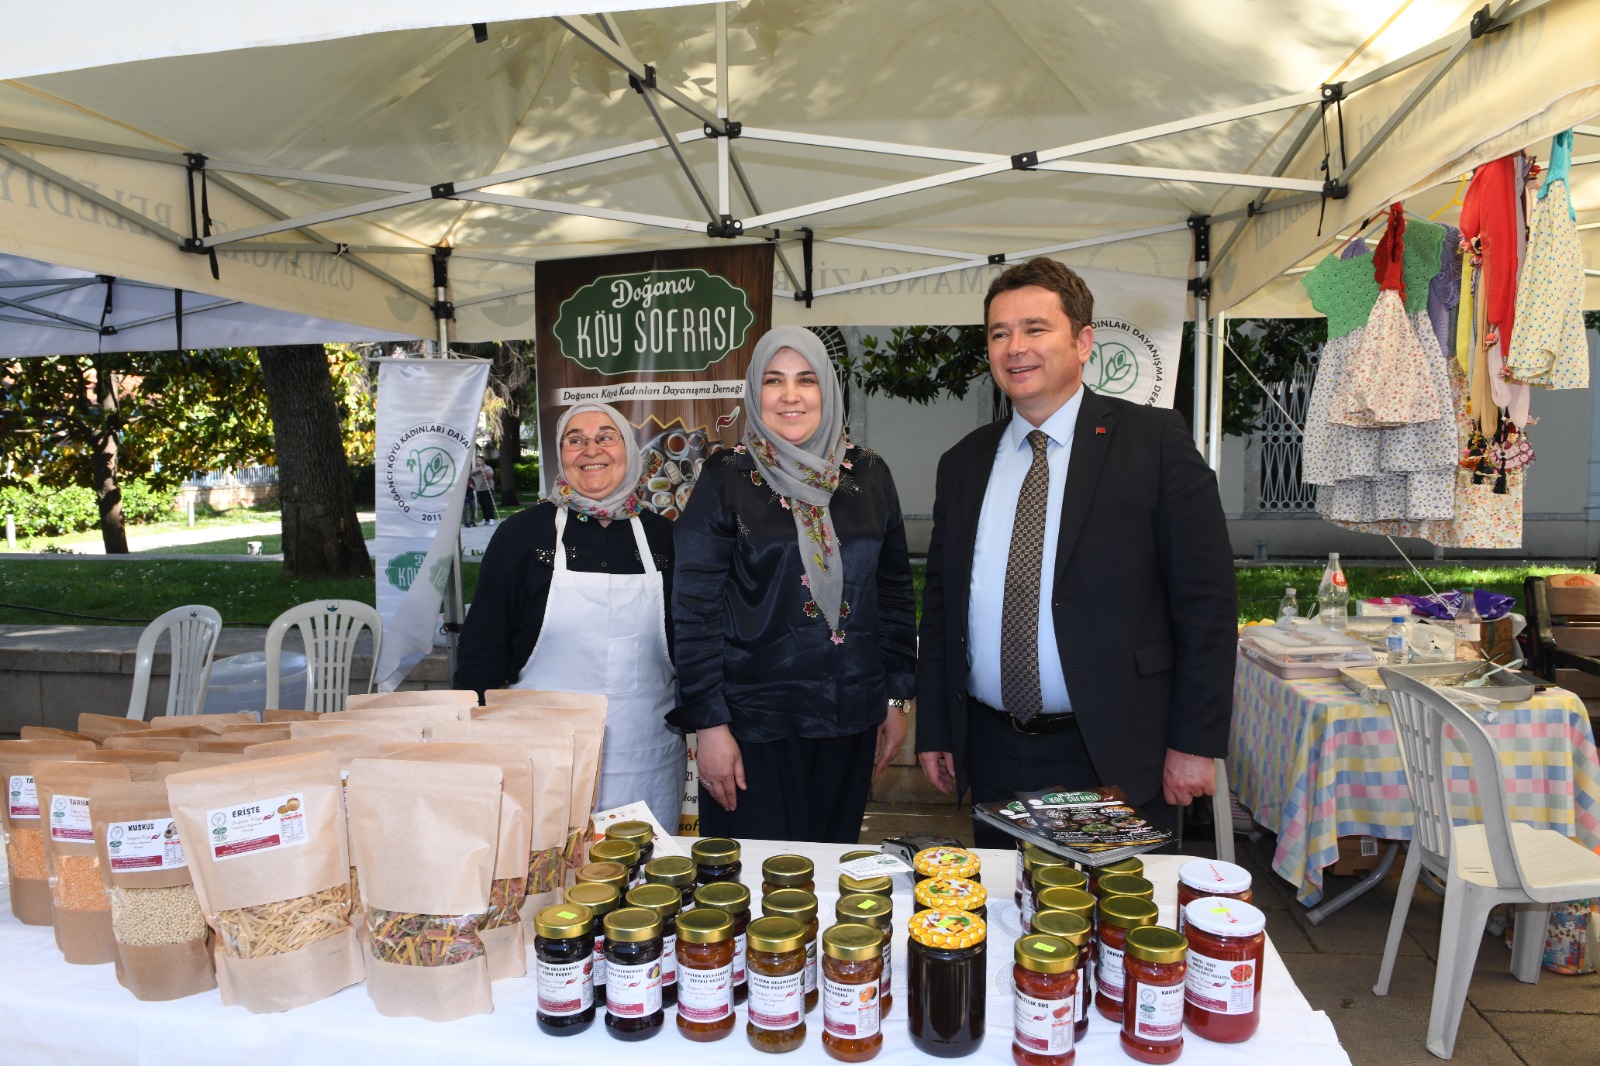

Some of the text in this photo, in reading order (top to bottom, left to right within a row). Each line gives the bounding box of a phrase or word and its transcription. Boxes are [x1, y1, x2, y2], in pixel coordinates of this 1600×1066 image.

[610, 276, 696, 308] Doğancı
[577, 306, 736, 358] KÖY SOFRASI
[1092, 320, 1131, 332] DINLARI
[1132, 328, 1163, 382] DAYANIŞMA
[563, 383, 743, 402] Doğancı Köyü Kadınları Dayanışma Derneği
[399, 425, 445, 444] KADINLARI
[447, 428, 470, 450] DAYA
[69, 798, 89, 807] TARHA
[232, 805, 261, 818] ERİŞTE
[128, 823, 154, 832] KUSKUS
